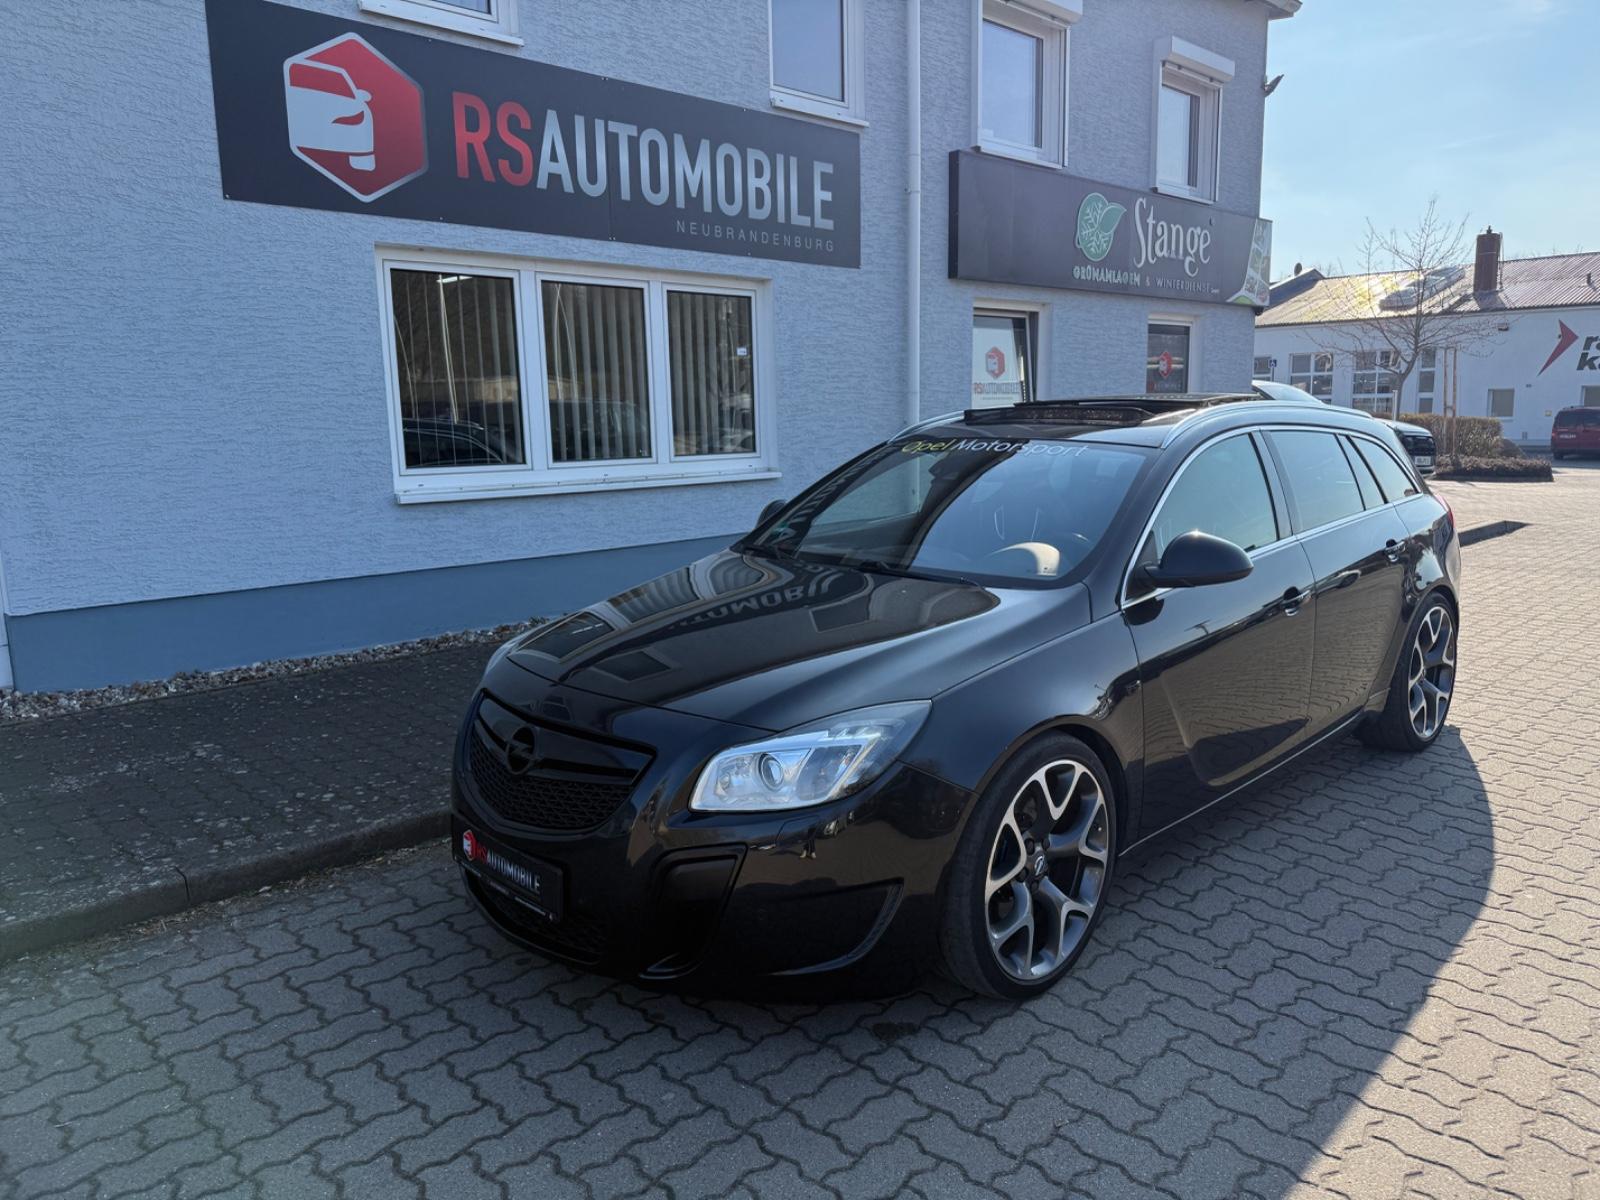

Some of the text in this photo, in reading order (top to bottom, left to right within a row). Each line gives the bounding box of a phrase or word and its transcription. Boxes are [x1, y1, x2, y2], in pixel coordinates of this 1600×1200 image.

[452, 90, 835, 231] RSAUTOMOBILE
[675, 219, 835, 252] NEUBRANDENBURG
[1132, 197, 1212, 278] Stange
[1582, 335, 1600, 351] r
[1576, 352, 1600, 371] k
